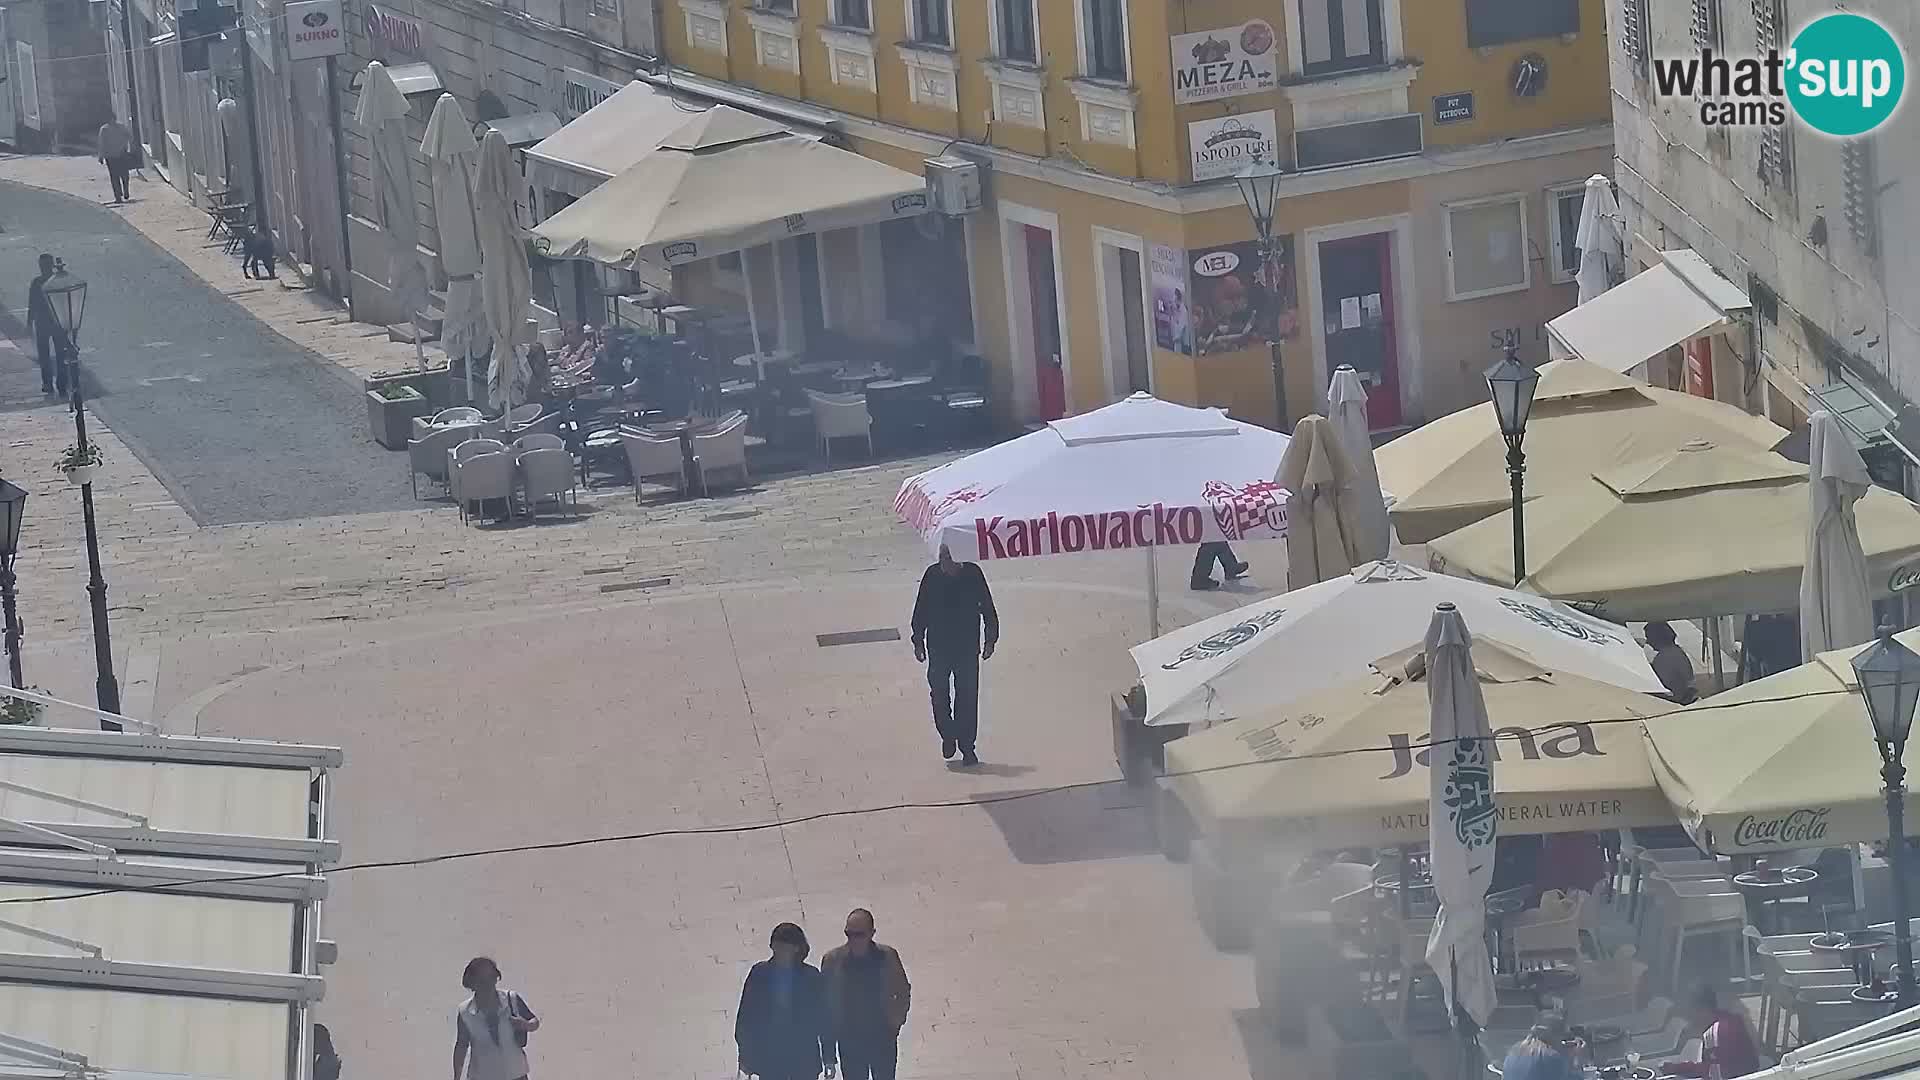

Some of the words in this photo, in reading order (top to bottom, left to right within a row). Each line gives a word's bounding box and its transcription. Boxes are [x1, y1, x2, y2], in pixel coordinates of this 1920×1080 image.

[296, 29, 338, 42] SUKNO
[1177, 59, 1256, 90] MEZA
[1186, 86, 1219, 98] PIZZERIA
[1227, 82, 1248, 92] GRILL
[1195, 145, 1241, 163] ISPOD
[975, 501, 1205, 561] Karlovačko
[1559, 799, 1622, 818] WATER
